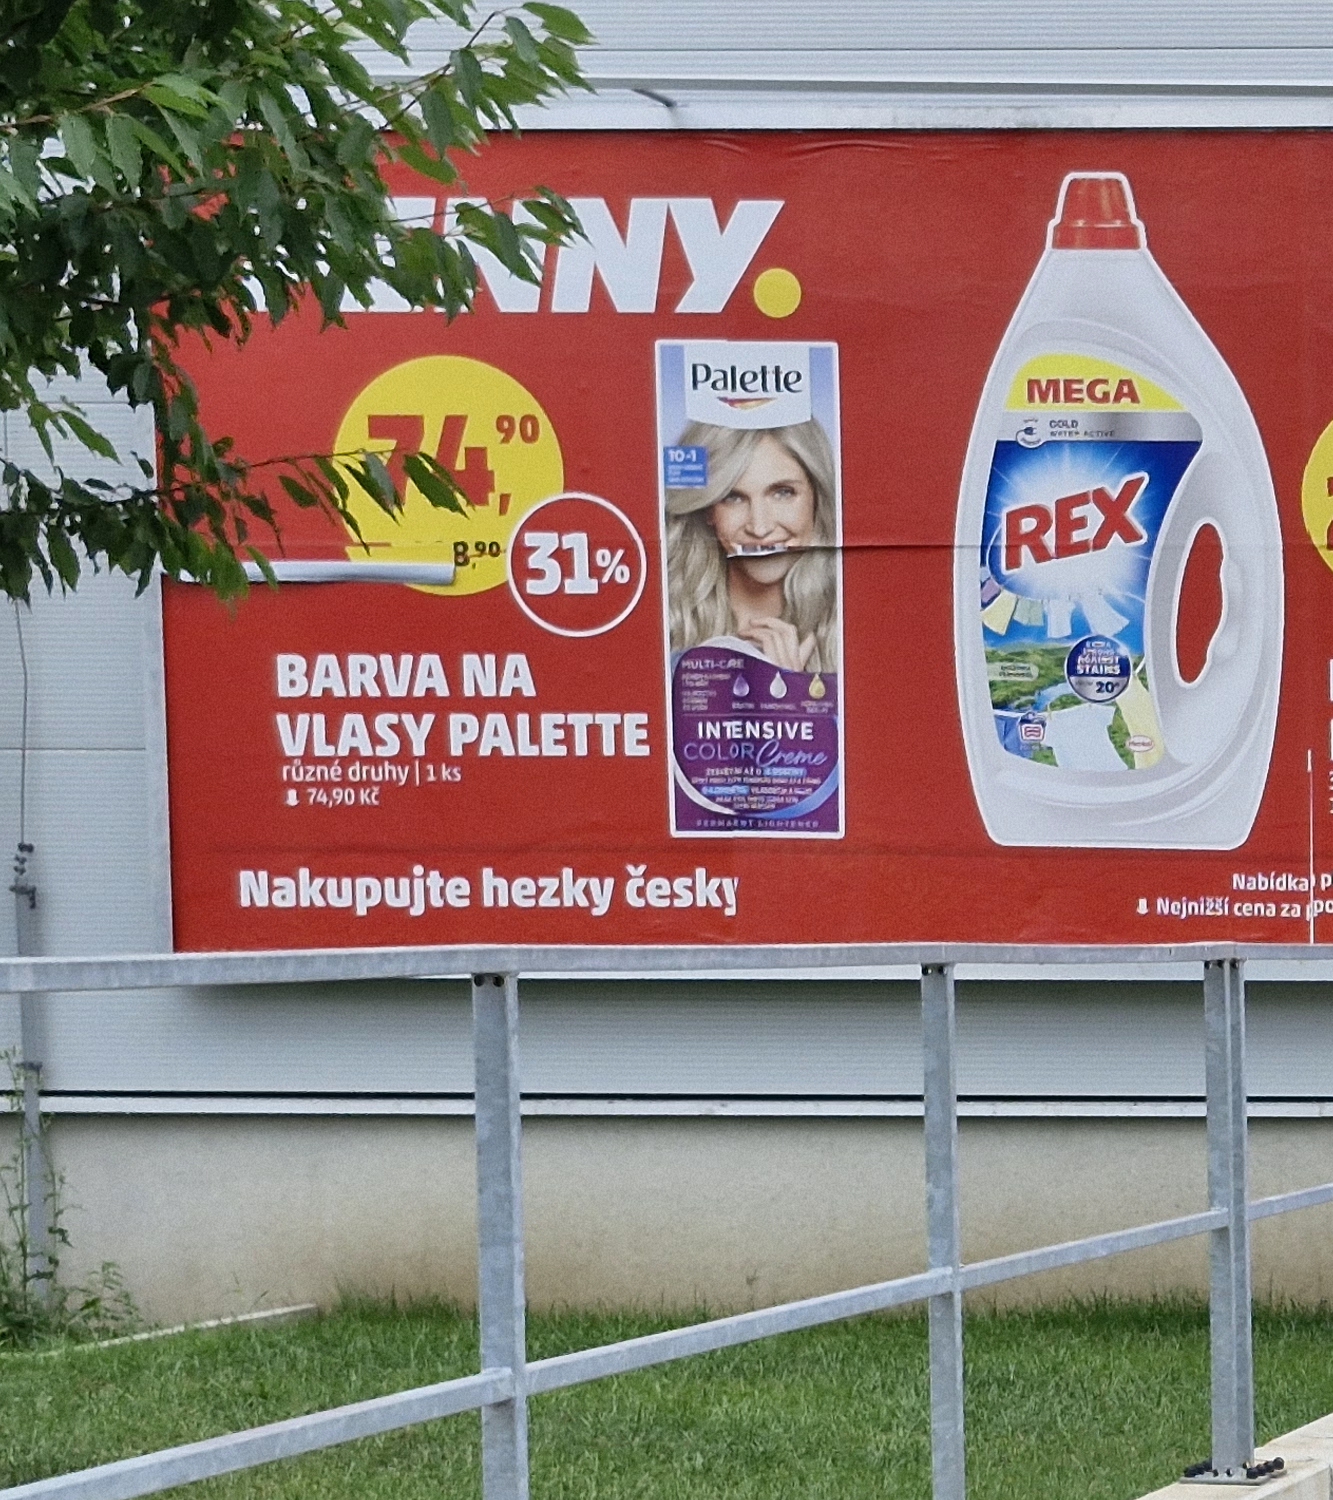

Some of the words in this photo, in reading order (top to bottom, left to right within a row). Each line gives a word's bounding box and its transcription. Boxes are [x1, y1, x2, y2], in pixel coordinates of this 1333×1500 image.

[243, 196, 801, 318] ENNY.
[691, 363, 803, 393] Palette
[1026, 378, 1140, 404] MEGA
[1004, 475, 1147, 571] REX
[524, 532, 631, 595] 31%
[276, 654, 450, 699] BARVA
[462, 653, 537, 699] NA
[276, 714, 436, 757] VLASY
[449, 713, 650, 757] PALETTE
[697, 720, 814, 740] INTENSIVE
[683, 742, 755, 760] COLOR
[755, 740, 828, 766] Creme
[282, 758, 342, 782] různé
[348, 760, 410, 786] druhy
[426, 764, 438, 782] 1
[441, 763, 462, 782] ks
[306, 787, 355, 808] 74,90
[360, 786, 380, 806] Kč
[239, 866, 471, 916] Nakupujte
[482, 867, 615, 916] hezky
[625, 865, 739, 916] česky
[1232, 872, 1309, 891] Nabídka
[1233, 901, 1276, 917] cena
[1280, 902, 1301, 918] za
